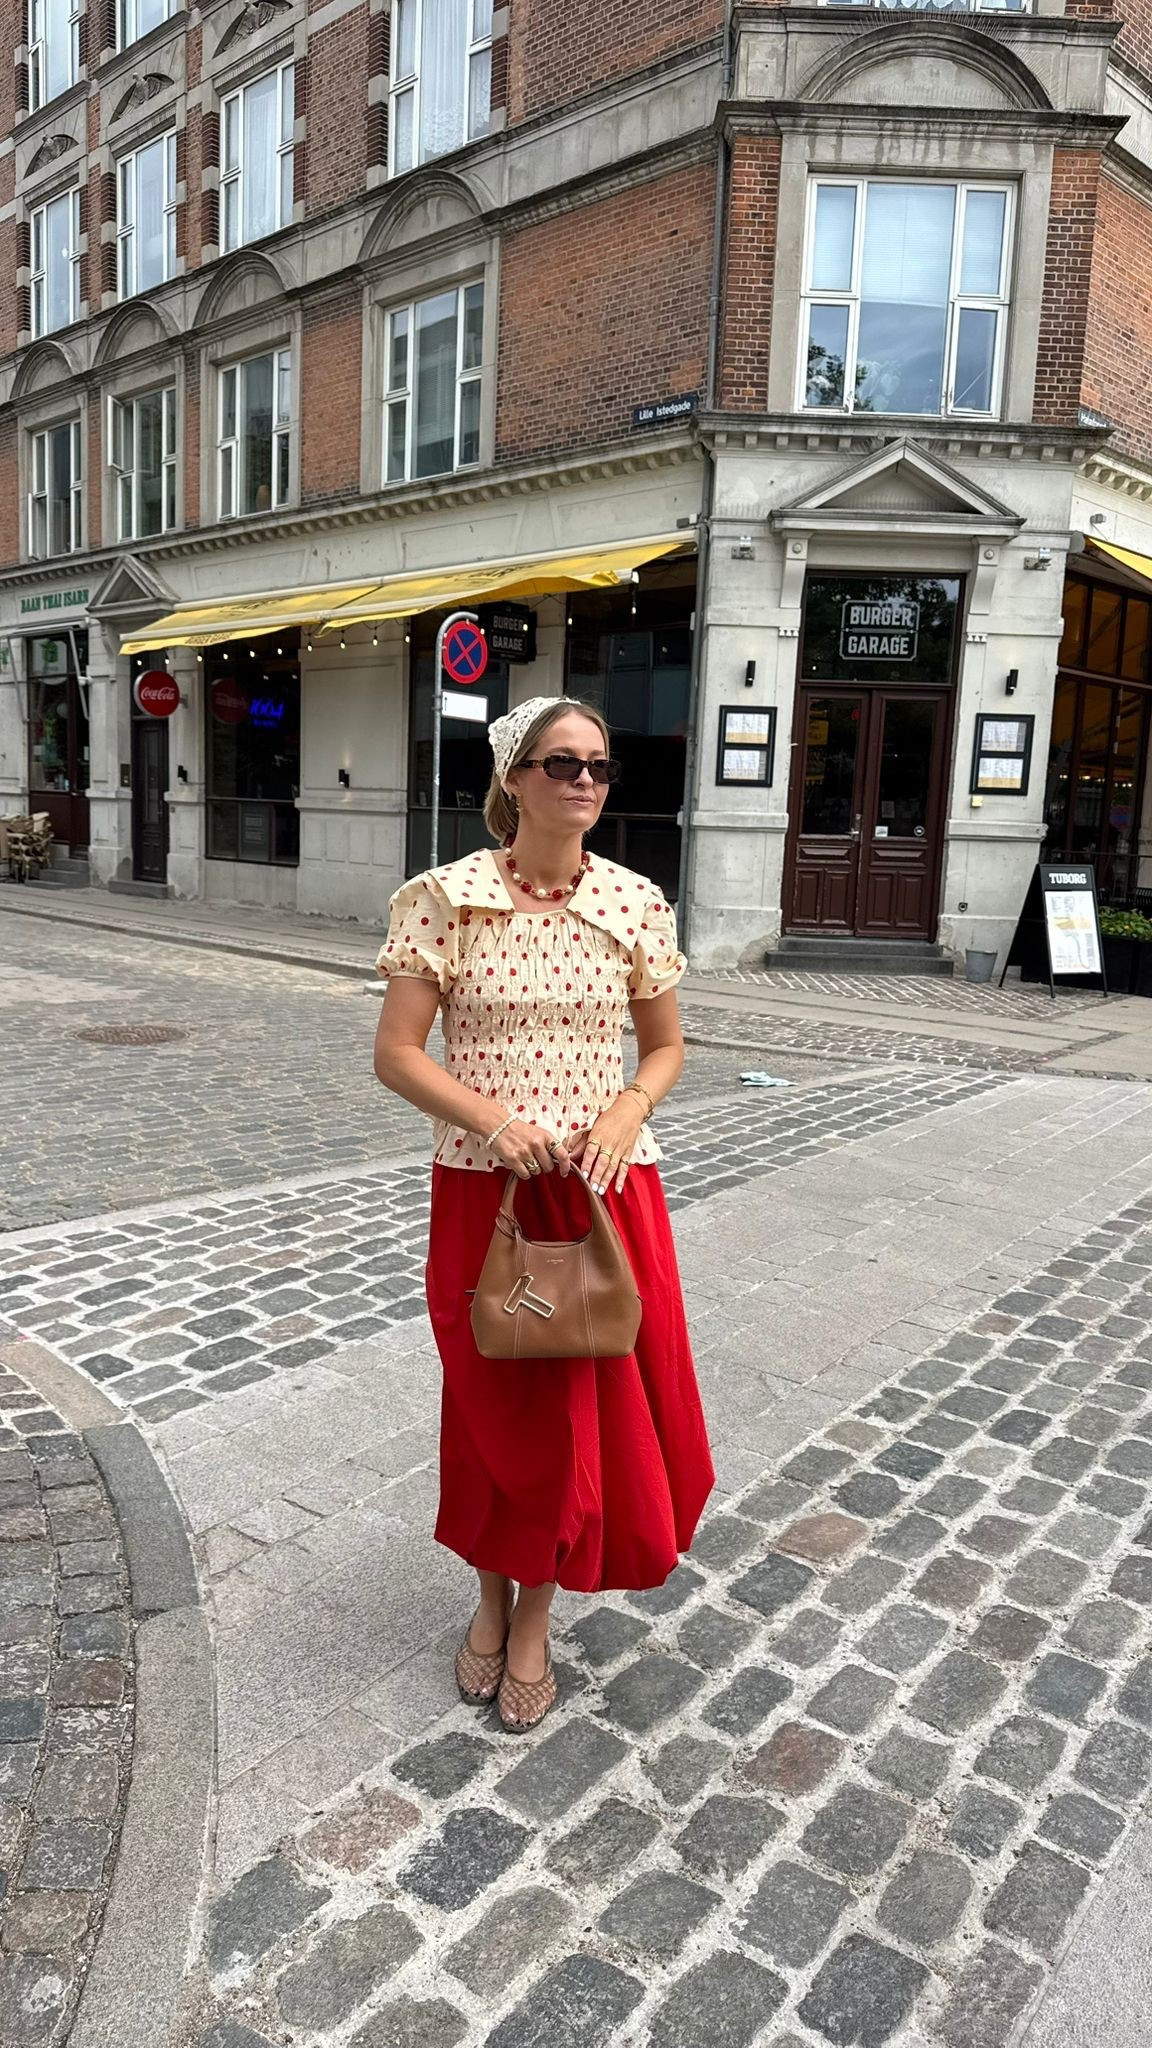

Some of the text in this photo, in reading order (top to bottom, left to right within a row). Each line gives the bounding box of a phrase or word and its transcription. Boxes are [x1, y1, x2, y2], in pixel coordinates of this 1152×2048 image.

[639, 401, 691, 420] Lille Istedgade
[42, 593, 62, 610] THAI
[63, 589, 89, 607] ISARN
[492, 615, 525, 632] BURGER
[850, 605, 912, 626] BURGER
[492, 634, 524, 652] GARAGE
[848, 635, 910, 655] GARAGE
[1048, 873, 1087, 884] TUBORG
